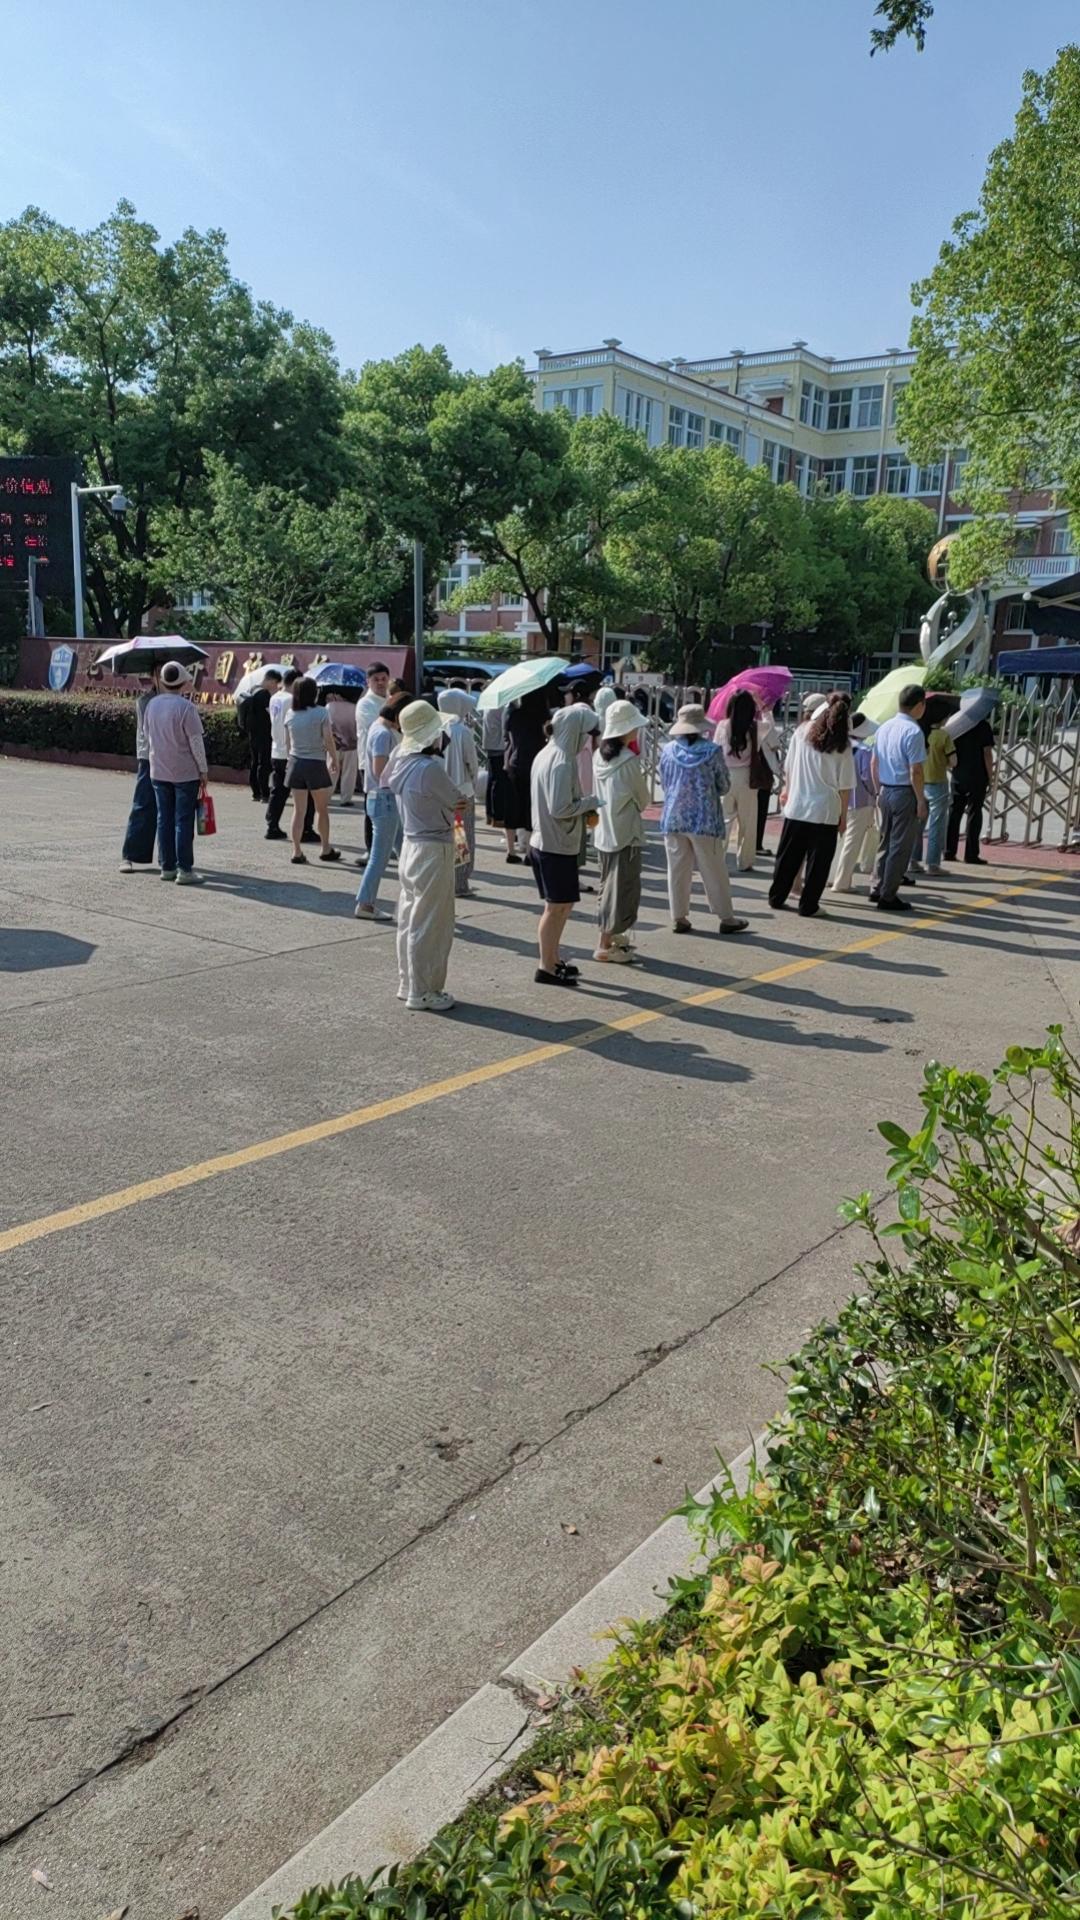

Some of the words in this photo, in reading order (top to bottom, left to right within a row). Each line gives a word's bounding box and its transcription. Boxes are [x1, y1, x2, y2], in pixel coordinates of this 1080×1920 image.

[0, 477, 52, 494] 价值观
[212, 692, 239, 705] LAN
